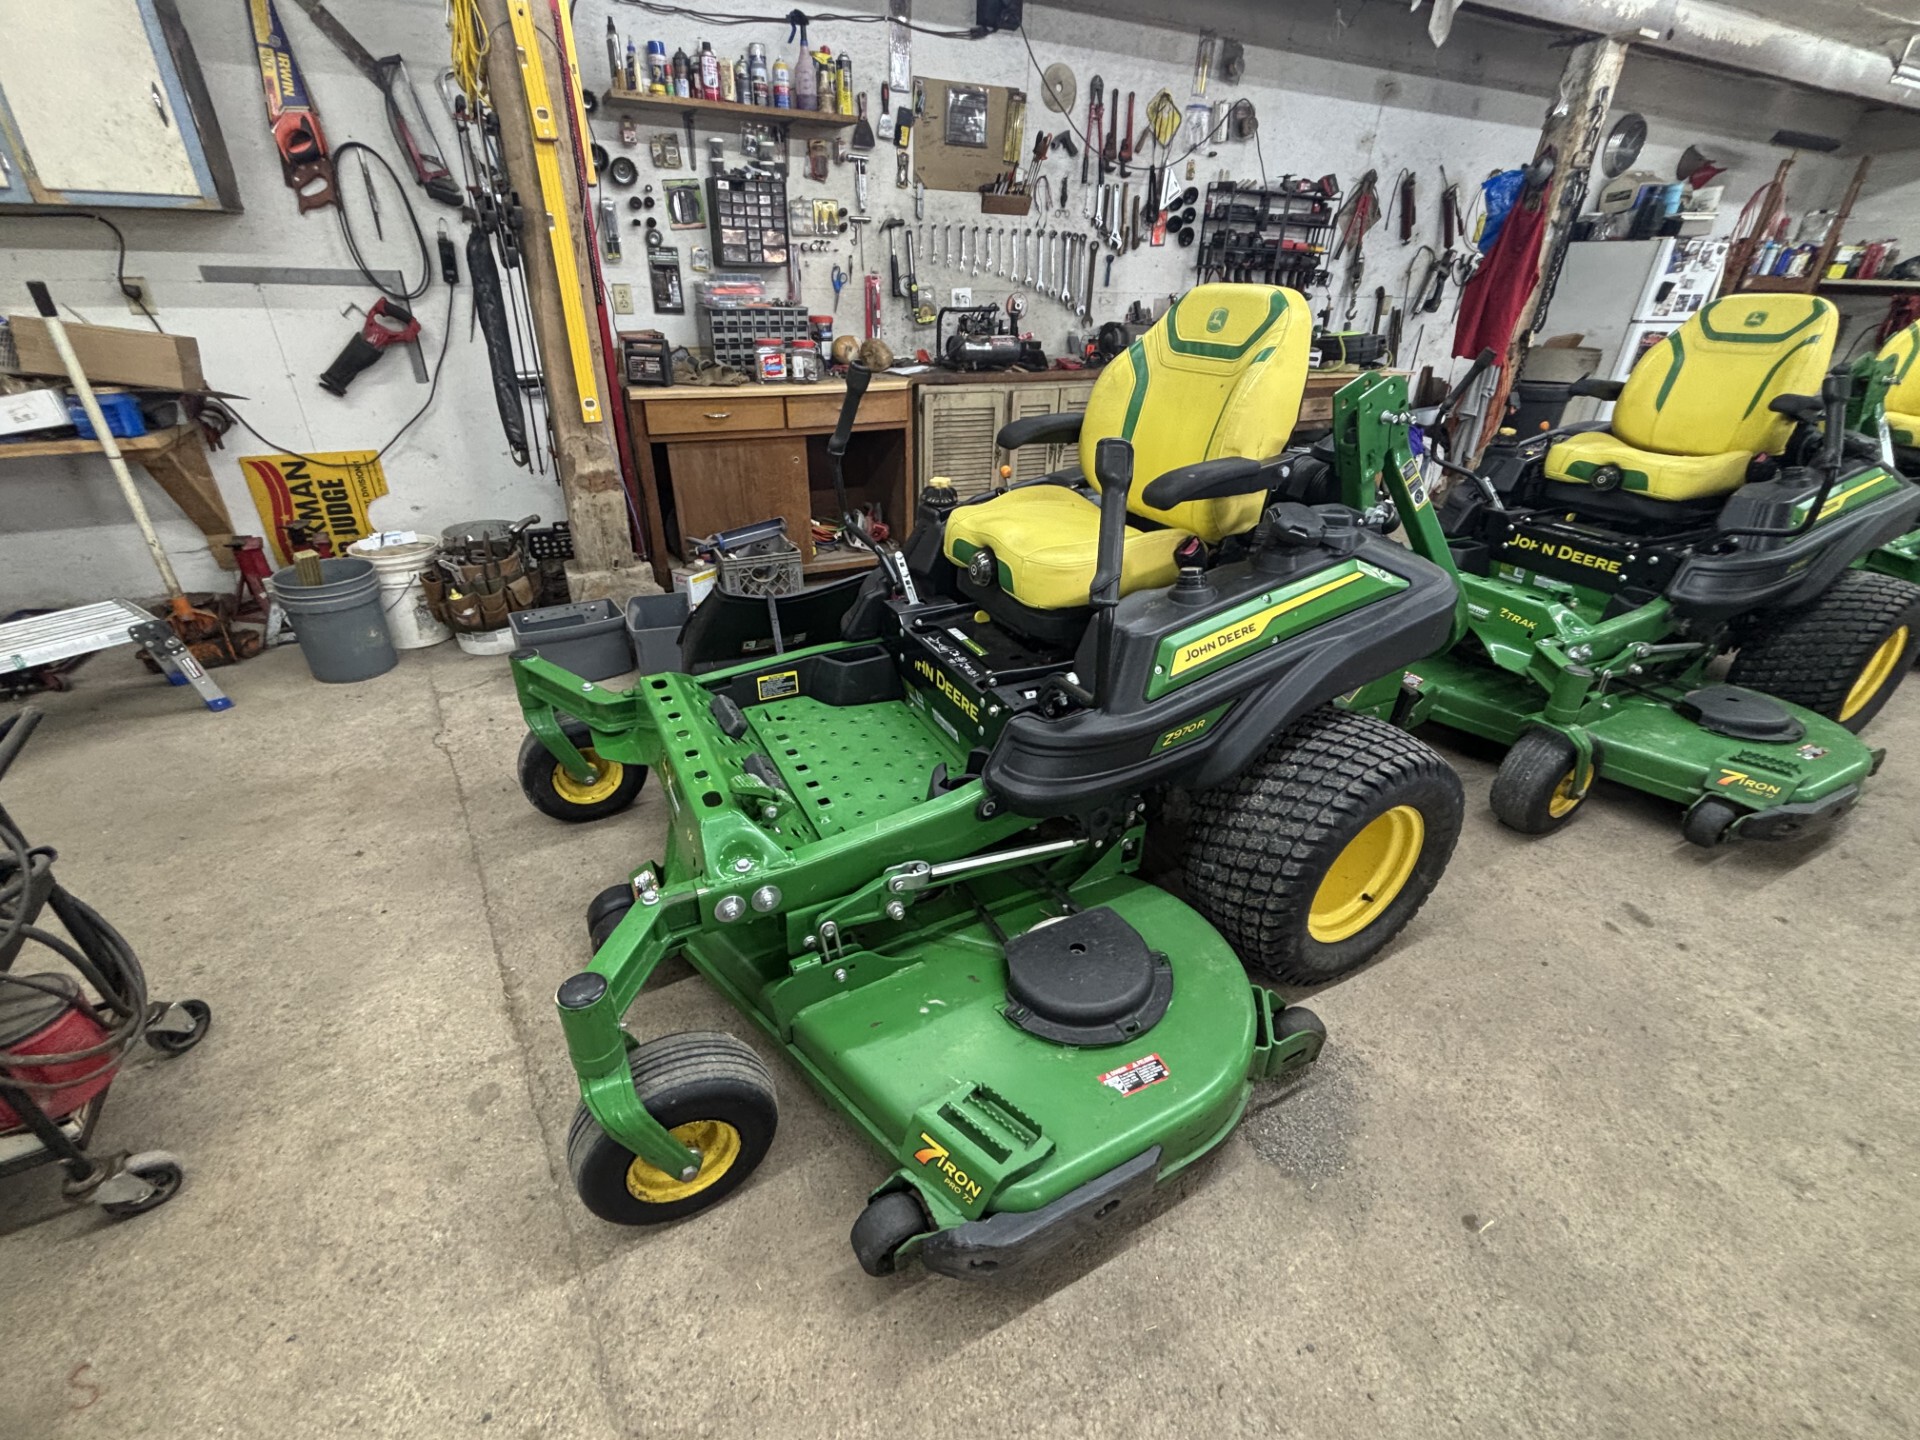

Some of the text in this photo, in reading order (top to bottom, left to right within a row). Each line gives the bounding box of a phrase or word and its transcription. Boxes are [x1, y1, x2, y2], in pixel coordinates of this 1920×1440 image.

[277, 52, 296, 97] IRWIN
[281, 460, 328, 541] KMAN
[317, 478, 360, 537] JUDGE
[1557, 545, 1622, 574] DEERE
[1500, 607, 1538, 630] ZTRAK
[1185, 623, 1257, 662] JOHN DEERE
[936, 669, 980, 723] DEERE
[1162, 719, 1206, 747] Z970R
[943, 1177, 974, 1206] PRO 72
